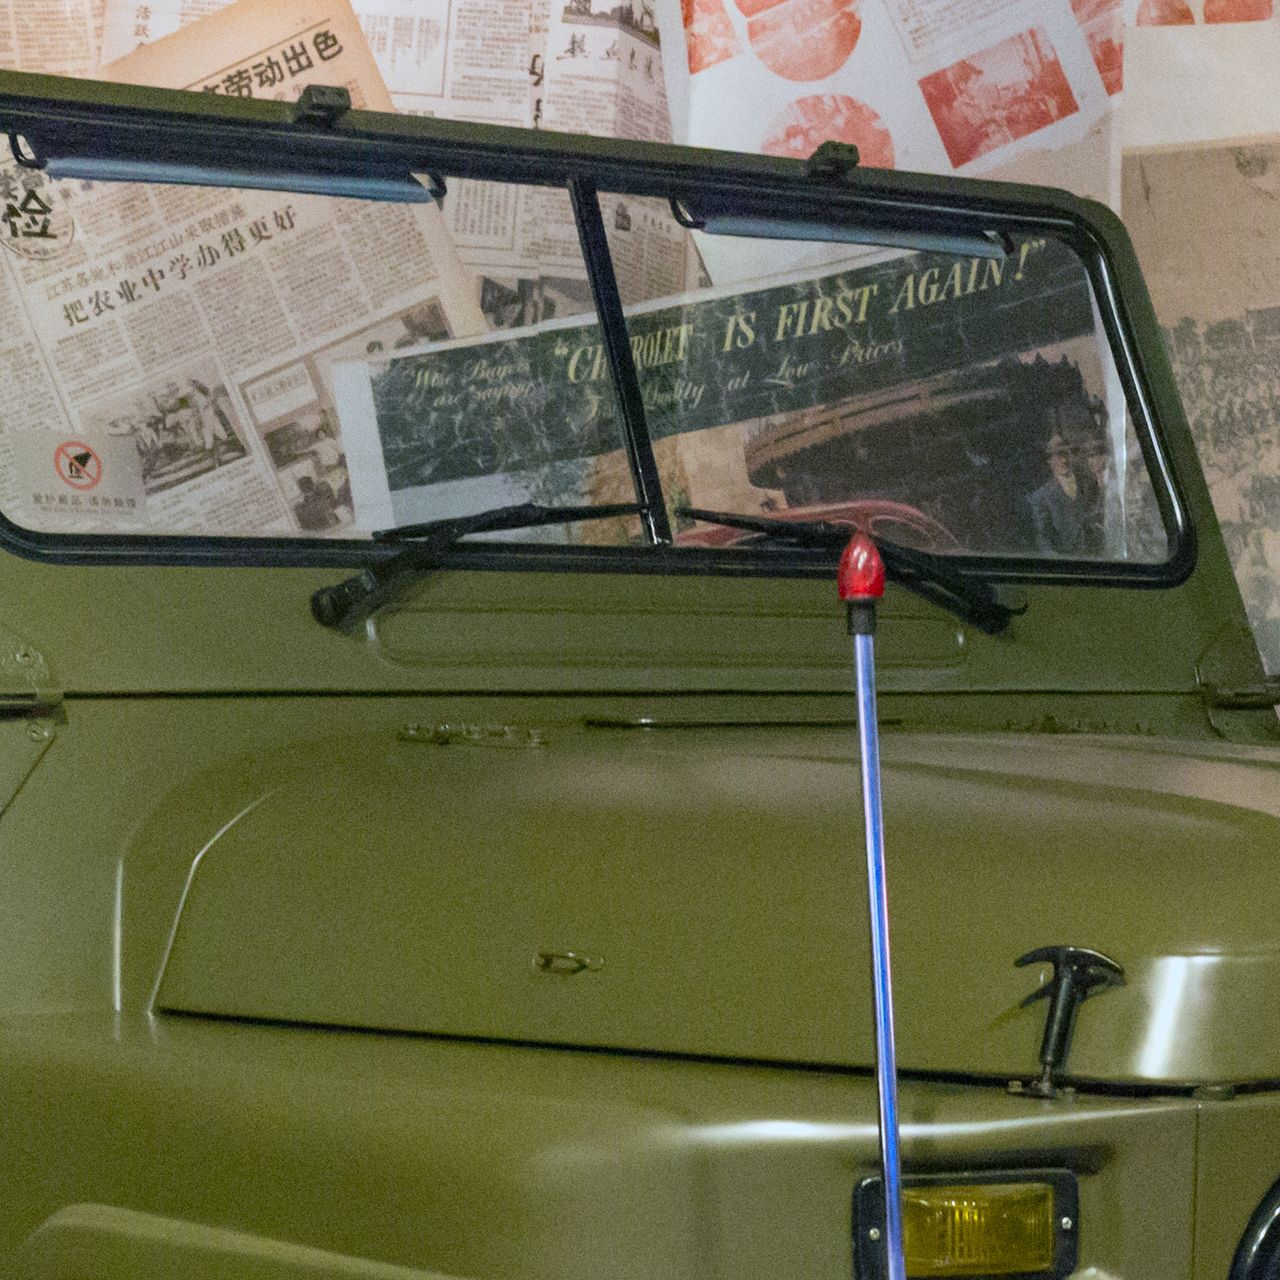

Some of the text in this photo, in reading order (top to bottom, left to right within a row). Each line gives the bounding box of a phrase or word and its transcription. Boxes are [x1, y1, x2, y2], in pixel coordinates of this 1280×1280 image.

[63, 205, 297, 326] 把农业中学办得更好
[723, 311, 756, 351] IS
[775, 284, 878, 341] FIRST
